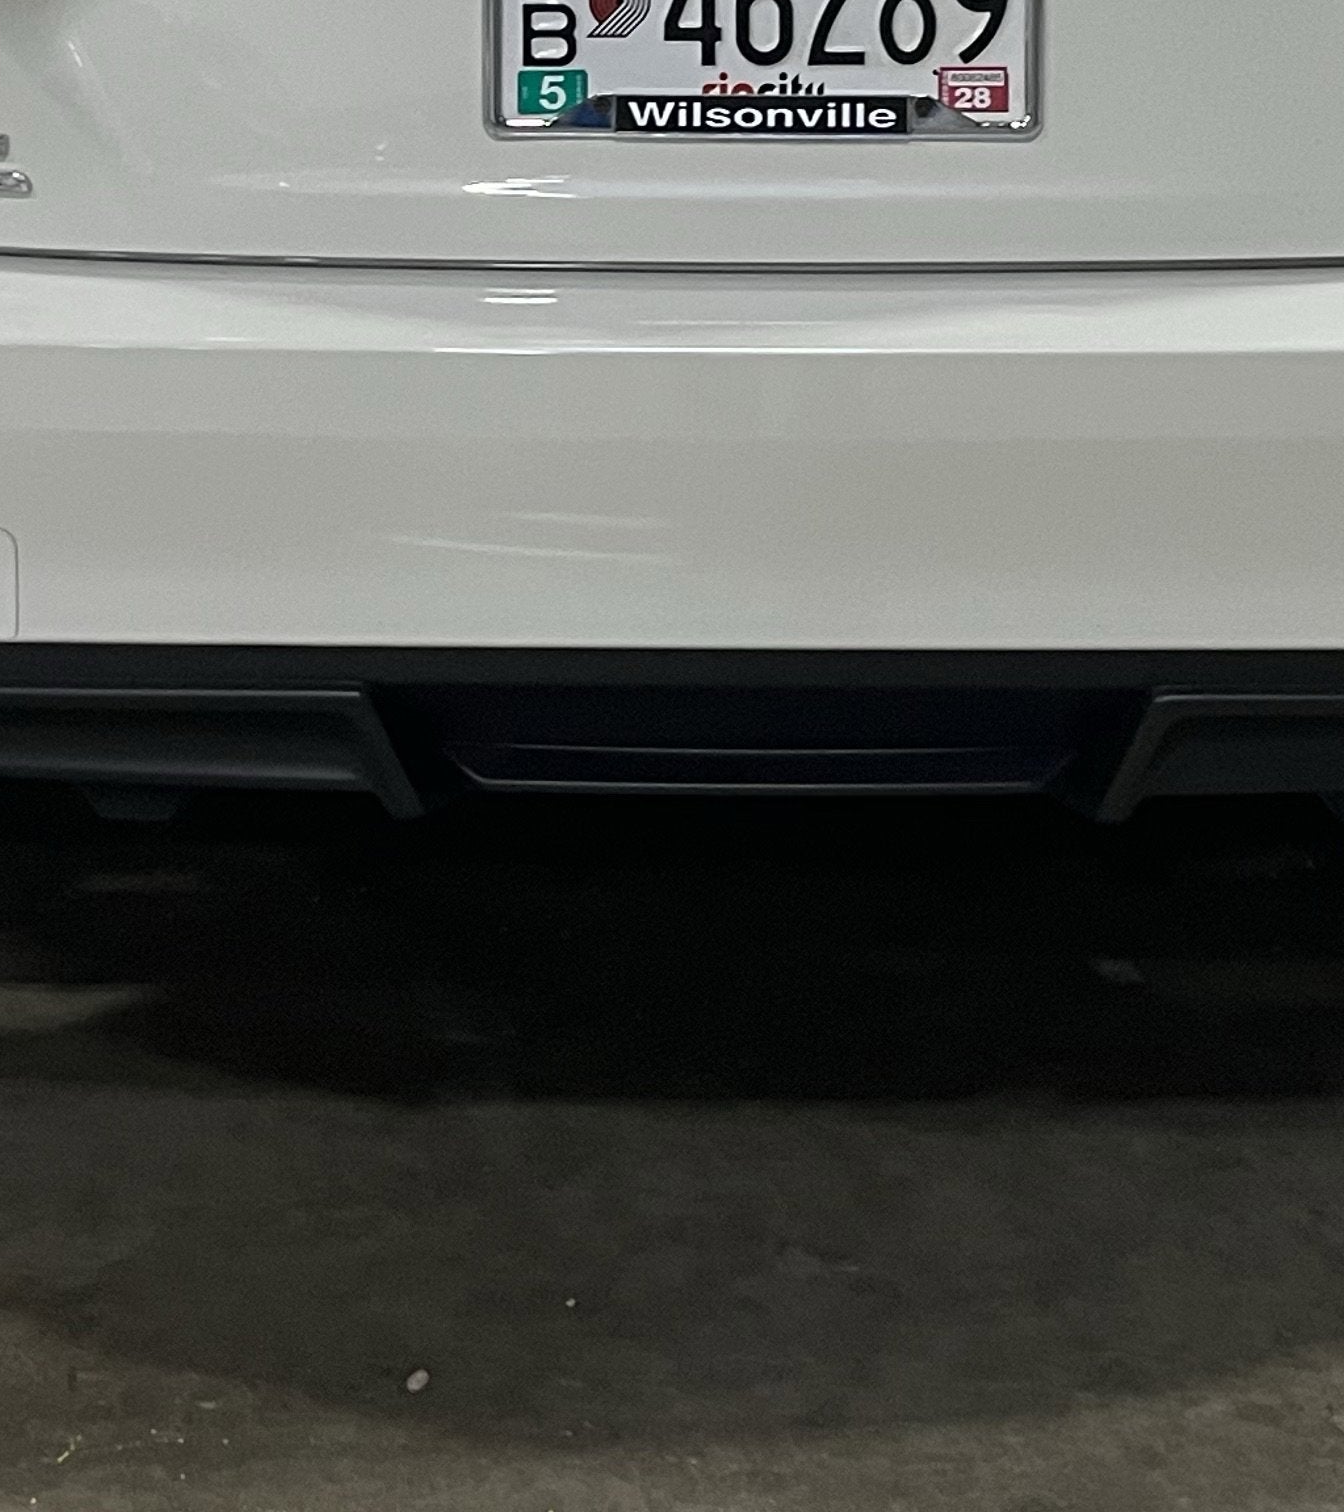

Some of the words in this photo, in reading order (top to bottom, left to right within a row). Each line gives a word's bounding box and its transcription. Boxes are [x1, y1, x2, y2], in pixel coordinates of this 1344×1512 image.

[538, 75, 567, 111] 5
[954, 87, 992, 109] 28
[627, 100, 898, 128] Wilsonville
